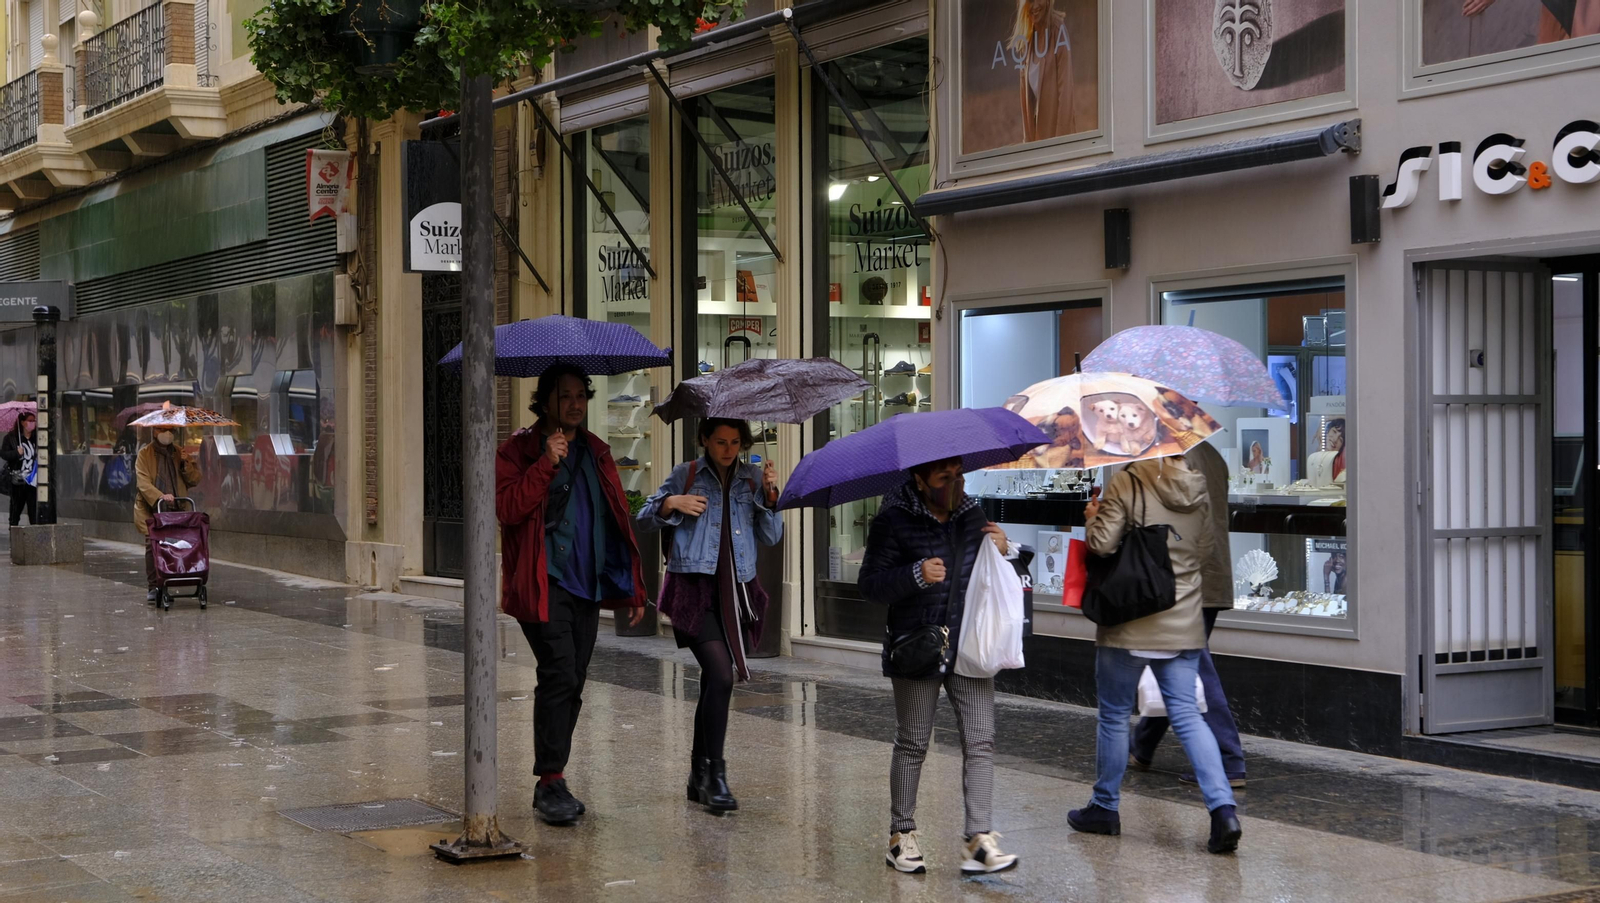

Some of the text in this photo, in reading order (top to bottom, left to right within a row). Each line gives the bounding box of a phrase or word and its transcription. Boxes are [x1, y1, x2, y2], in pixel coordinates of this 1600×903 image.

[991, 24, 1070, 70] AQUA
[420, 220, 462, 237] Suiz
[853, 235, 922, 273] Market
[601, 272, 649, 303] Market
[730, 320, 760, 332] CAMPER
[1324, 378, 1346, 387] AQU
